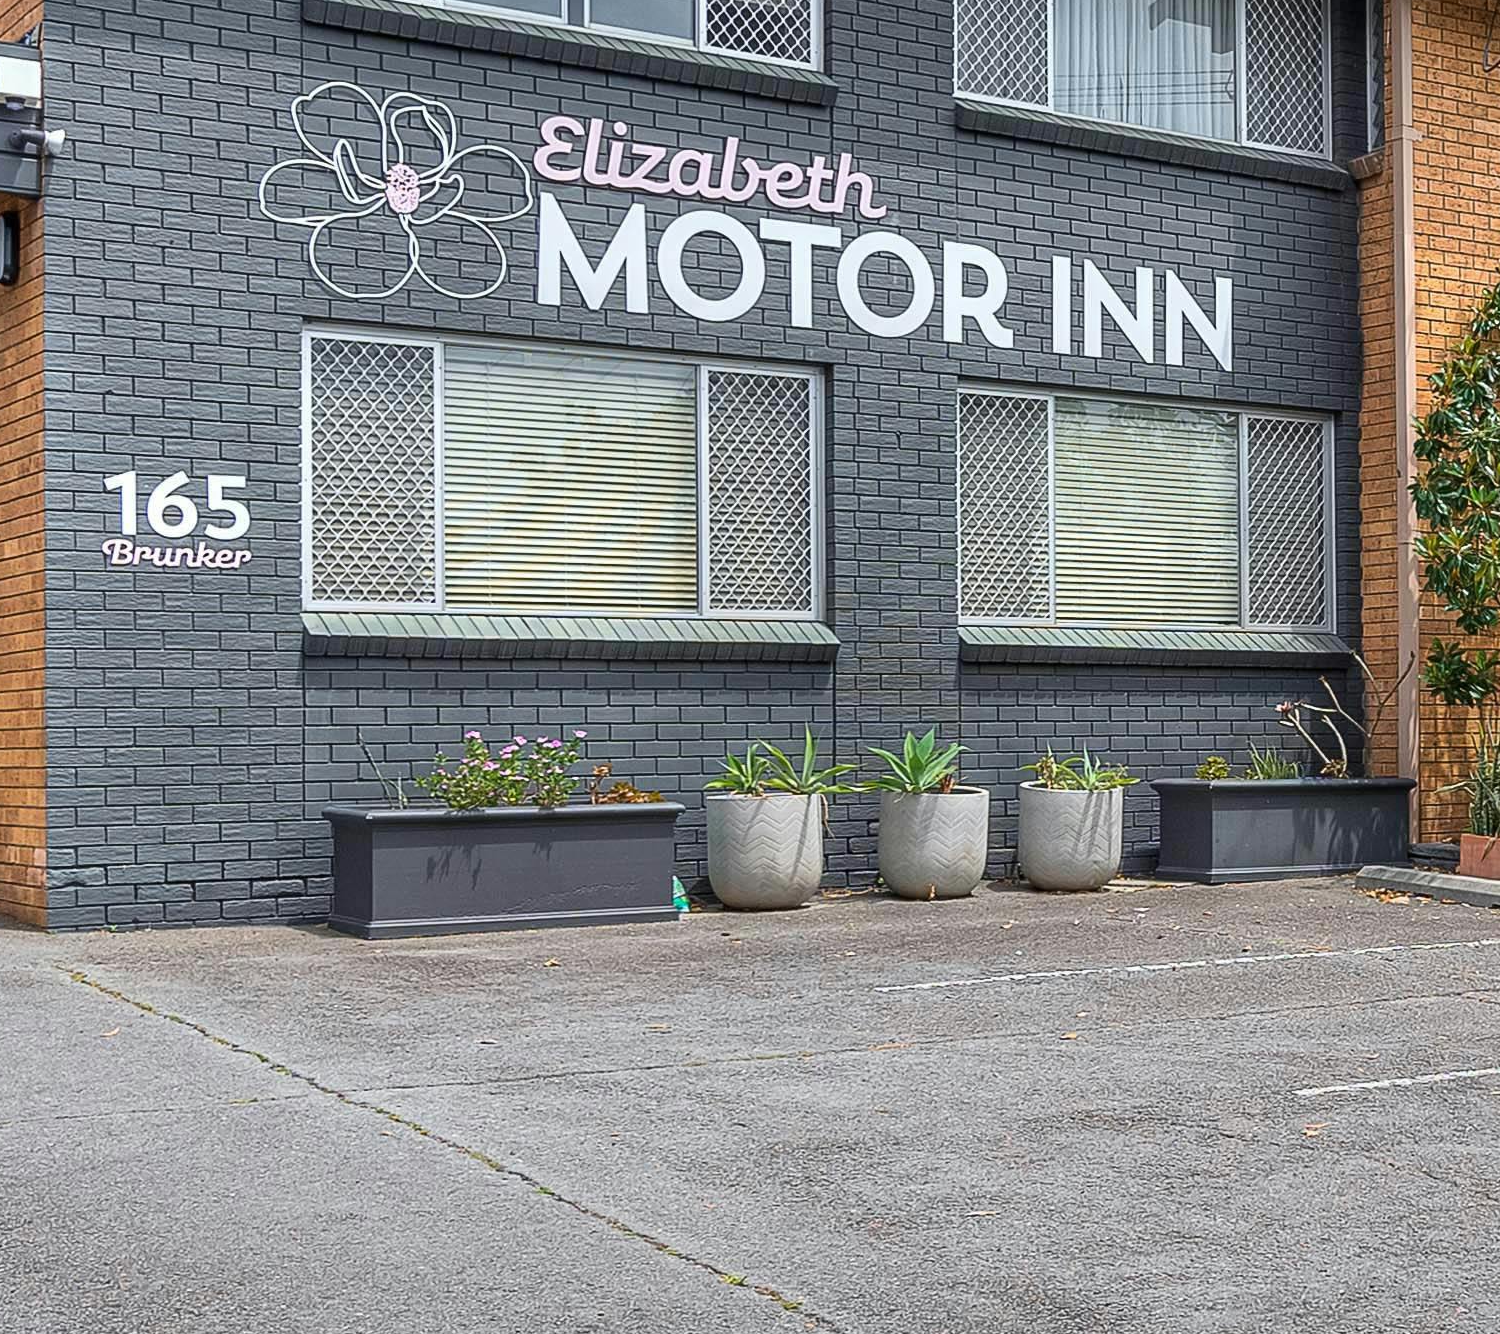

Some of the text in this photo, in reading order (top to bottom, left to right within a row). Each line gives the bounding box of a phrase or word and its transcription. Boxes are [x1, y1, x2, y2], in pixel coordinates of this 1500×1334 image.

[532, 115, 888, 219] Elizabeth
[537, 191, 1234, 373] MOTOR INN
[103, 470, 251, 541] 165
[101, 538, 253, 569] Brunker
